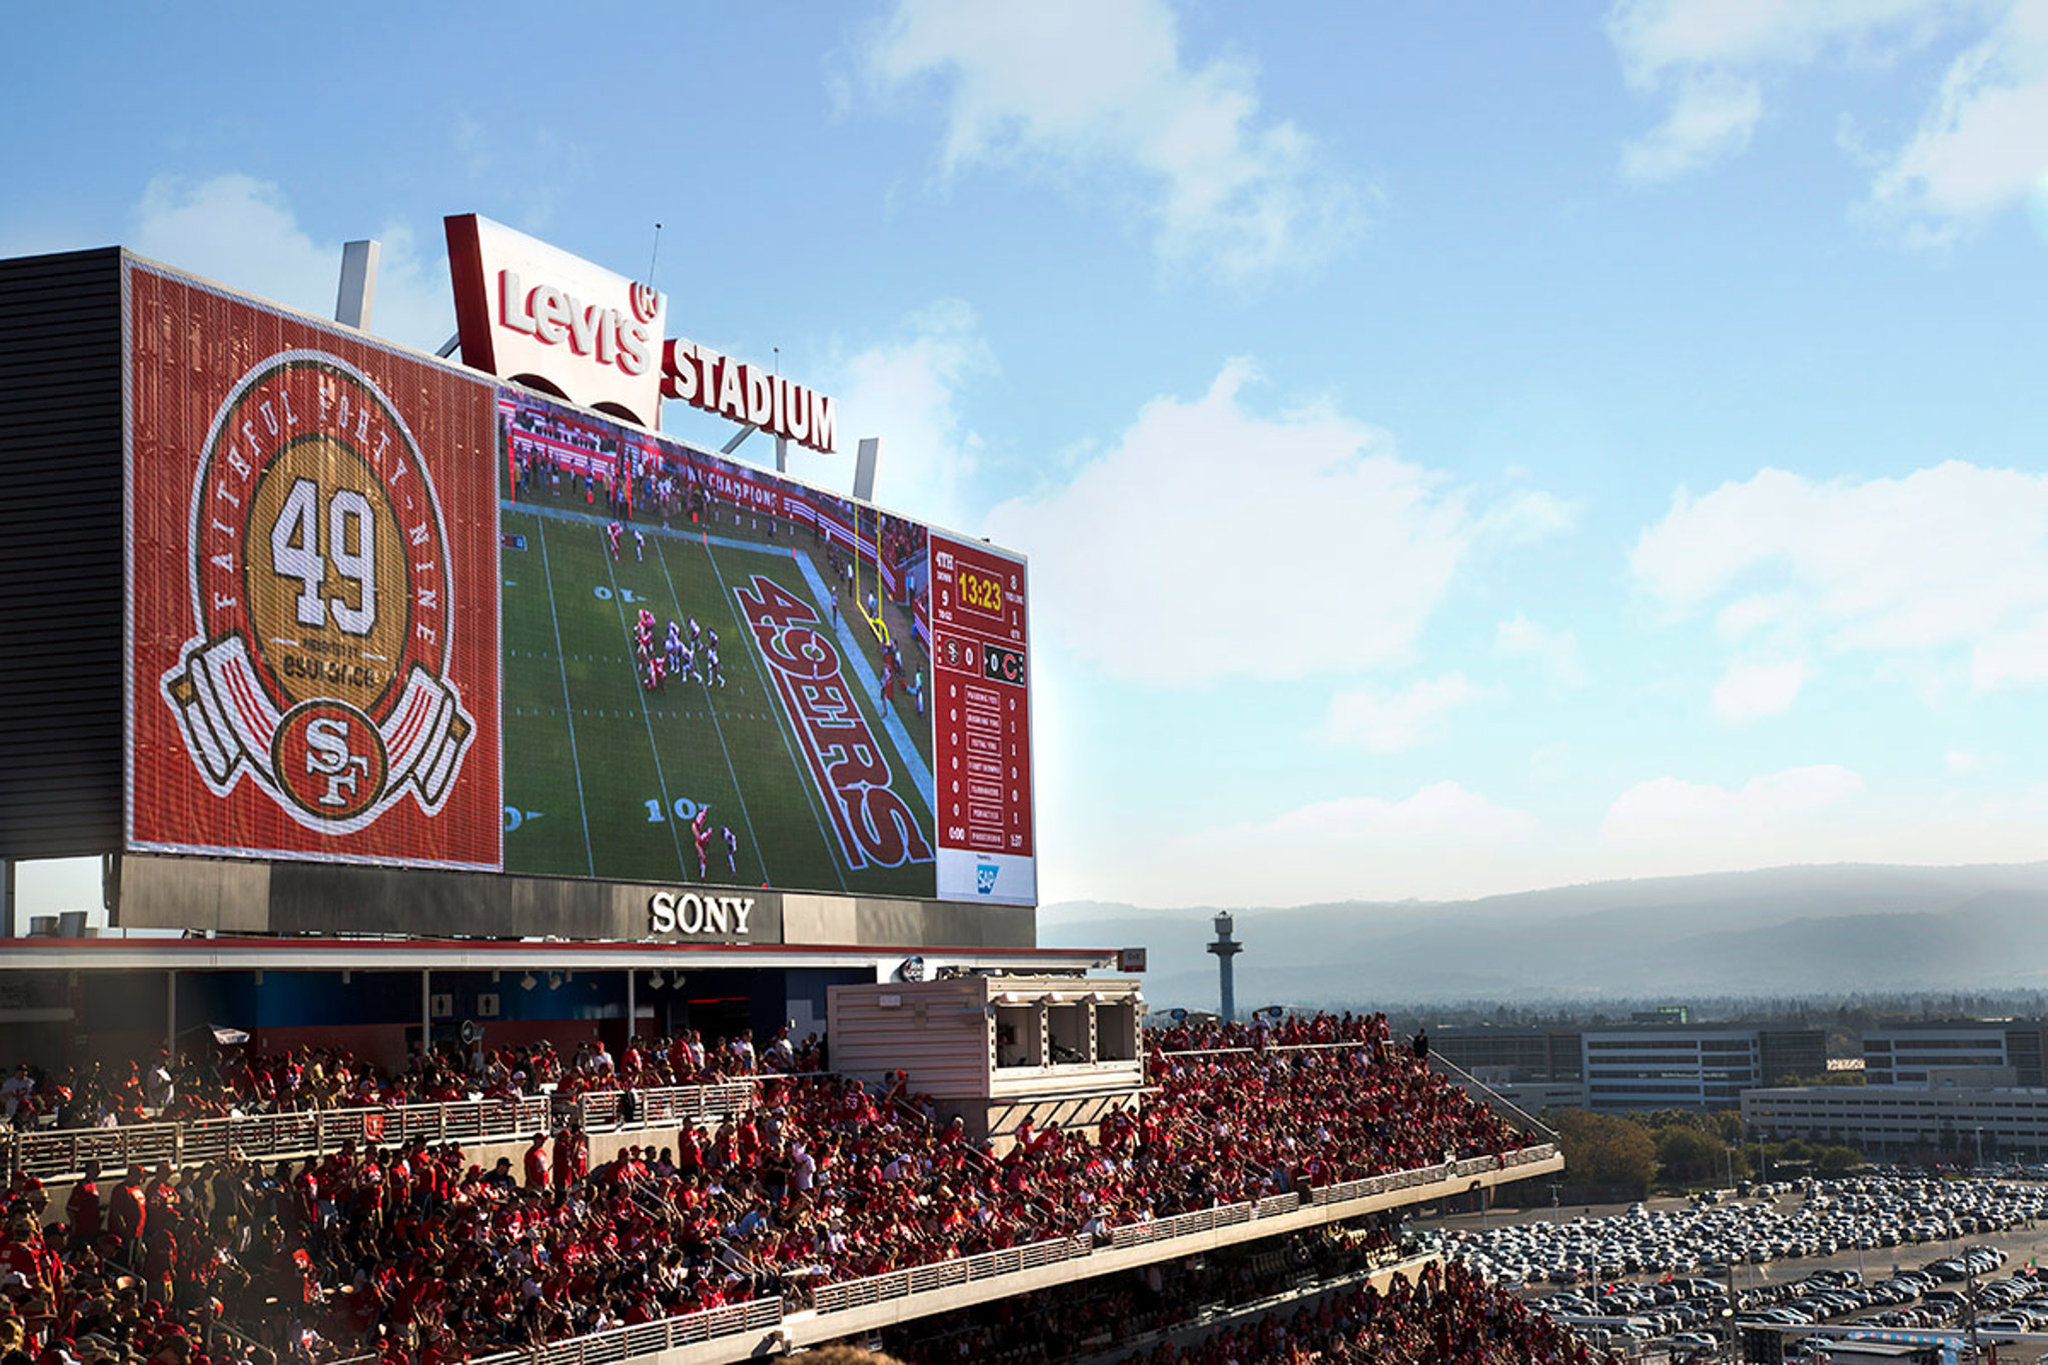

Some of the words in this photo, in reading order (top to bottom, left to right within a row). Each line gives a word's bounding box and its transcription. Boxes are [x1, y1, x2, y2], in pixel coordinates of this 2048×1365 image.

[668, 338, 839, 453] STADIUM
[211, 390, 299, 611] FAITHFUL
[271, 478, 376, 636] 49
[959, 572, 1002, 611] 13:23
[965, 647, 974, 666] 0
[991, 653, 999, 672] 0
[1003, 654, 1017, 680] C
[304, 717, 371, 808] SF
[733, 575, 935, 868] 49ERS
[650, 892, 755, 934] SONY
[978, 869, 996, 889] SAP
